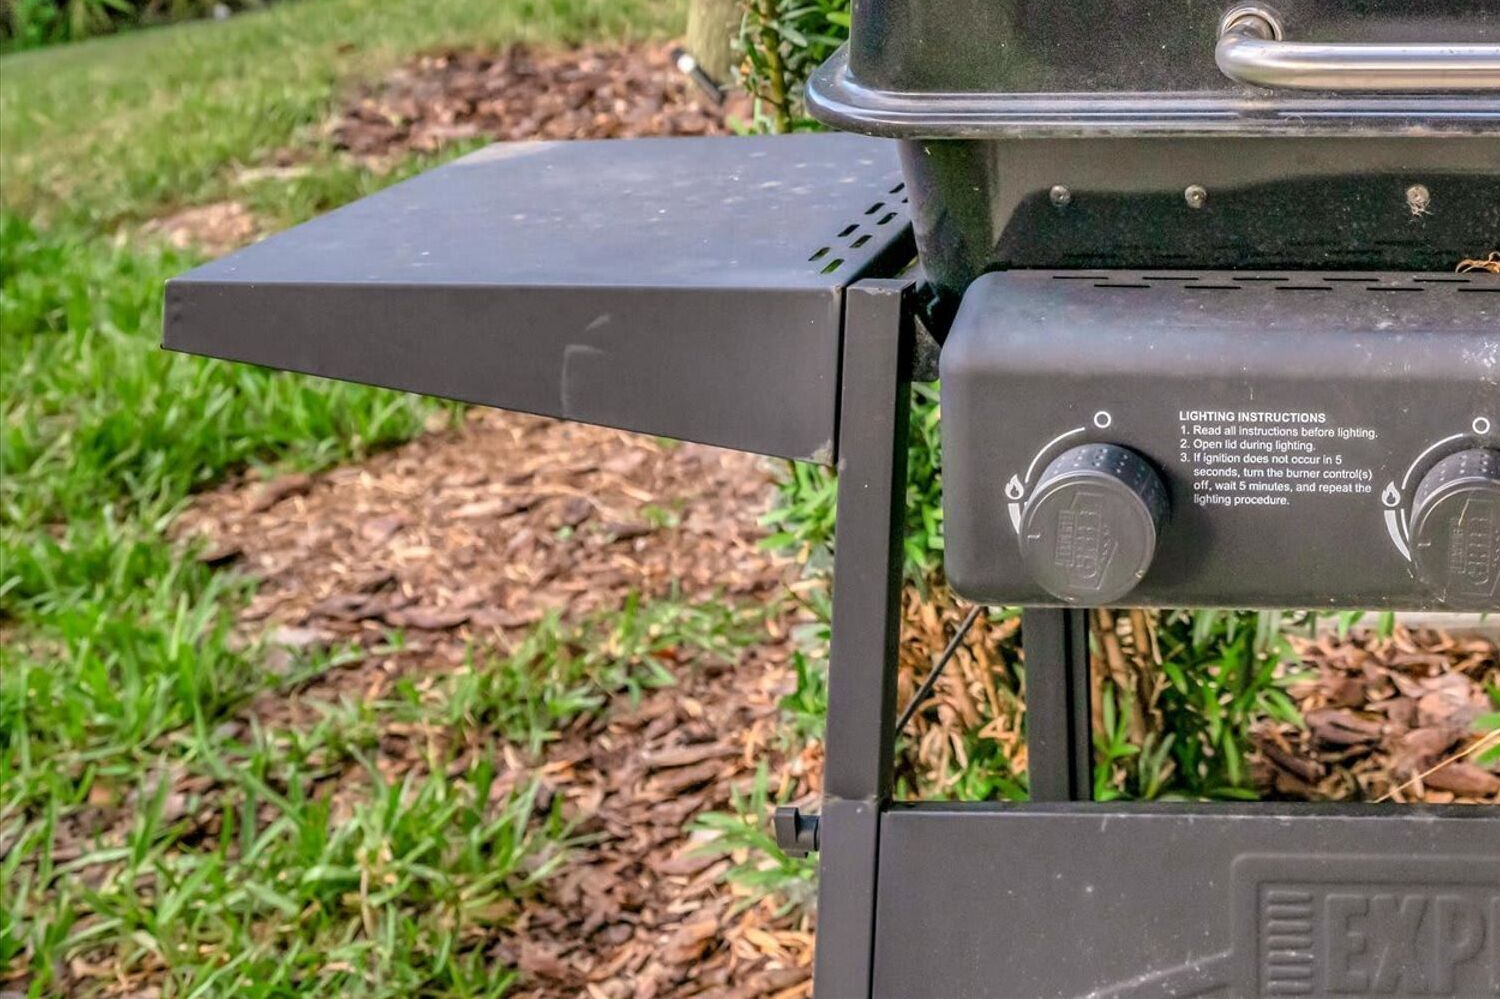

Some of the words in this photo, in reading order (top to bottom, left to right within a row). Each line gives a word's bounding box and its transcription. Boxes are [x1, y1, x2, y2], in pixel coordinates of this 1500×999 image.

[1179, 410, 1235, 421] LIGHTING
[1238, 411, 1326, 423] INSTRUCTIONS
[1181, 424, 1190, 435] 1.
[1193, 424, 1221, 435] Read
[1224, 425, 1236, 436] all
[1239, 426, 1299, 437] instructions
[1301, 427, 1335, 438] before
[1337, 427, 1378, 440] lighting.
[1180, 438, 1190, 449] 2.
[1193, 438, 1222, 451] Open
[1225, 439, 1237, 449] lid
[1240, 440, 1273, 452] during
[1275, 441, 1316, 453] lighting.
[1180, 452, 1190, 463] 3.
[1193, 452, 1200, 463] If
[1203, 453, 1240, 465] ignition
[1243, 453, 1269, 464] does
[1271, 454, 1289, 465] not
[1291, 455, 1320, 465] occur
[1322, 454, 1333, 465] in
[1335, 454, 1342, 465] 5
[1193, 467, 1241, 478] seconds,
[1243, 468, 1264, 477] turn
[1266, 467, 1284, 478] the
[1286, 468, 1320, 478] burner
[1322, 468, 1373, 481] control(s)
[1193, 480, 1212, 491] off,
[1214, 481, 1237, 491] wait
[1239, 481, 1246, 491] 5
[1248, 481, 1294, 492] minutes,
[1296, 482, 1316, 492] and
[1318, 483, 1353, 495] repeat
[1355, 483, 1372, 493] the
[1193, 494, 1232, 506] lighting
[1234, 495, 1290, 506] procedure.
